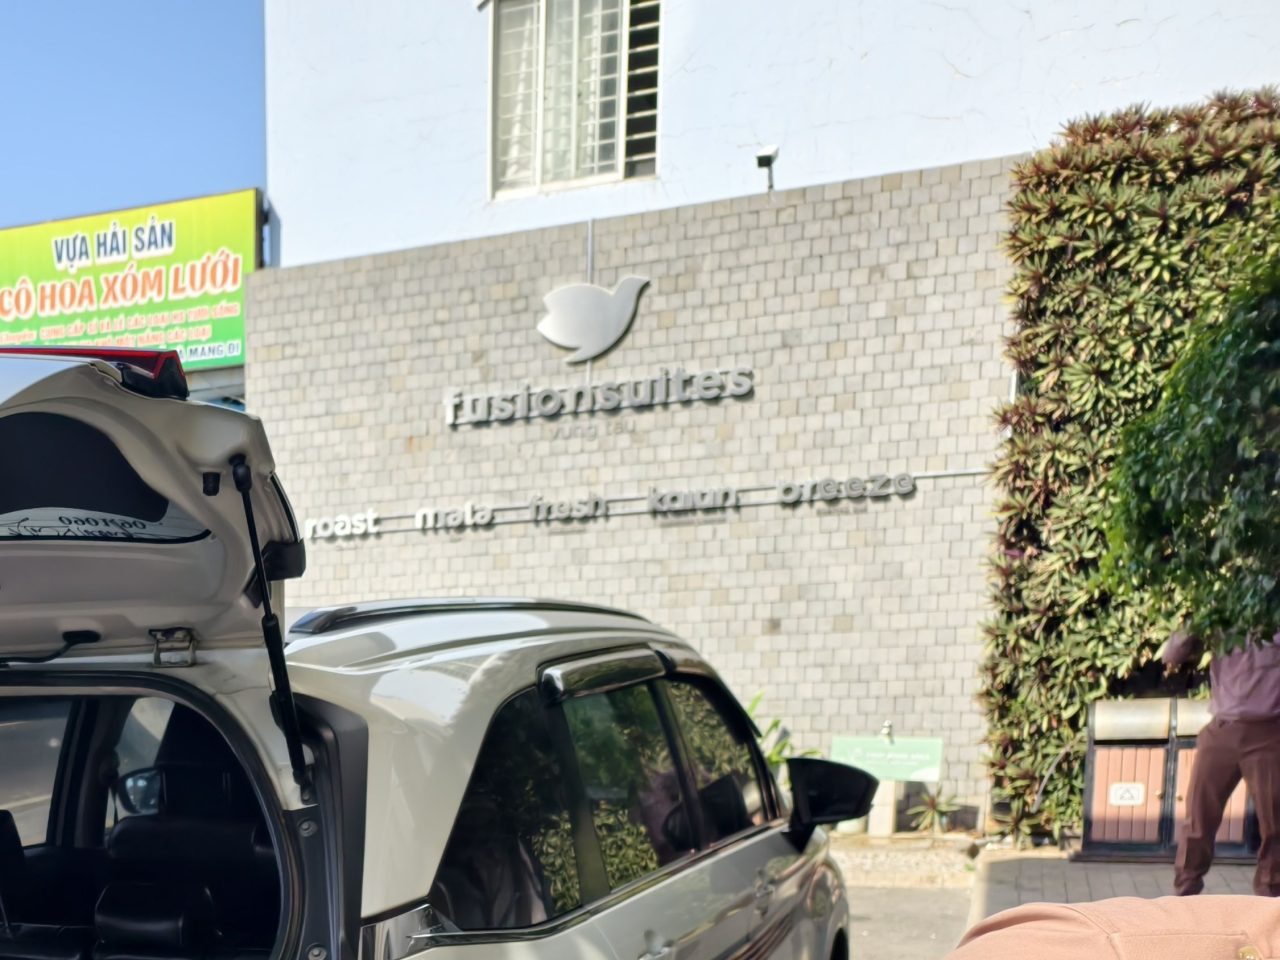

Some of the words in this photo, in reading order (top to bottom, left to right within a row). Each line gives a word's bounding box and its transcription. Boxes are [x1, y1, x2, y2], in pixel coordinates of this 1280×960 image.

[54, 234, 90, 268] VỰA
[96, 222, 126, 259] HẢI
[133, 215, 174, 252] SẢN
[39, 278, 95, 313] HOA
[102, 263, 164, 305] XÓM
[171, 249, 240, 296] LƯỚI
[188, 343, 225, 358] MANG
[444, 366, 755, 426] fusionsuites
[304, 508, 380, 540] roast
[530, 493, 606, 521] fresh
[776, 472, 915, 504] breeze
